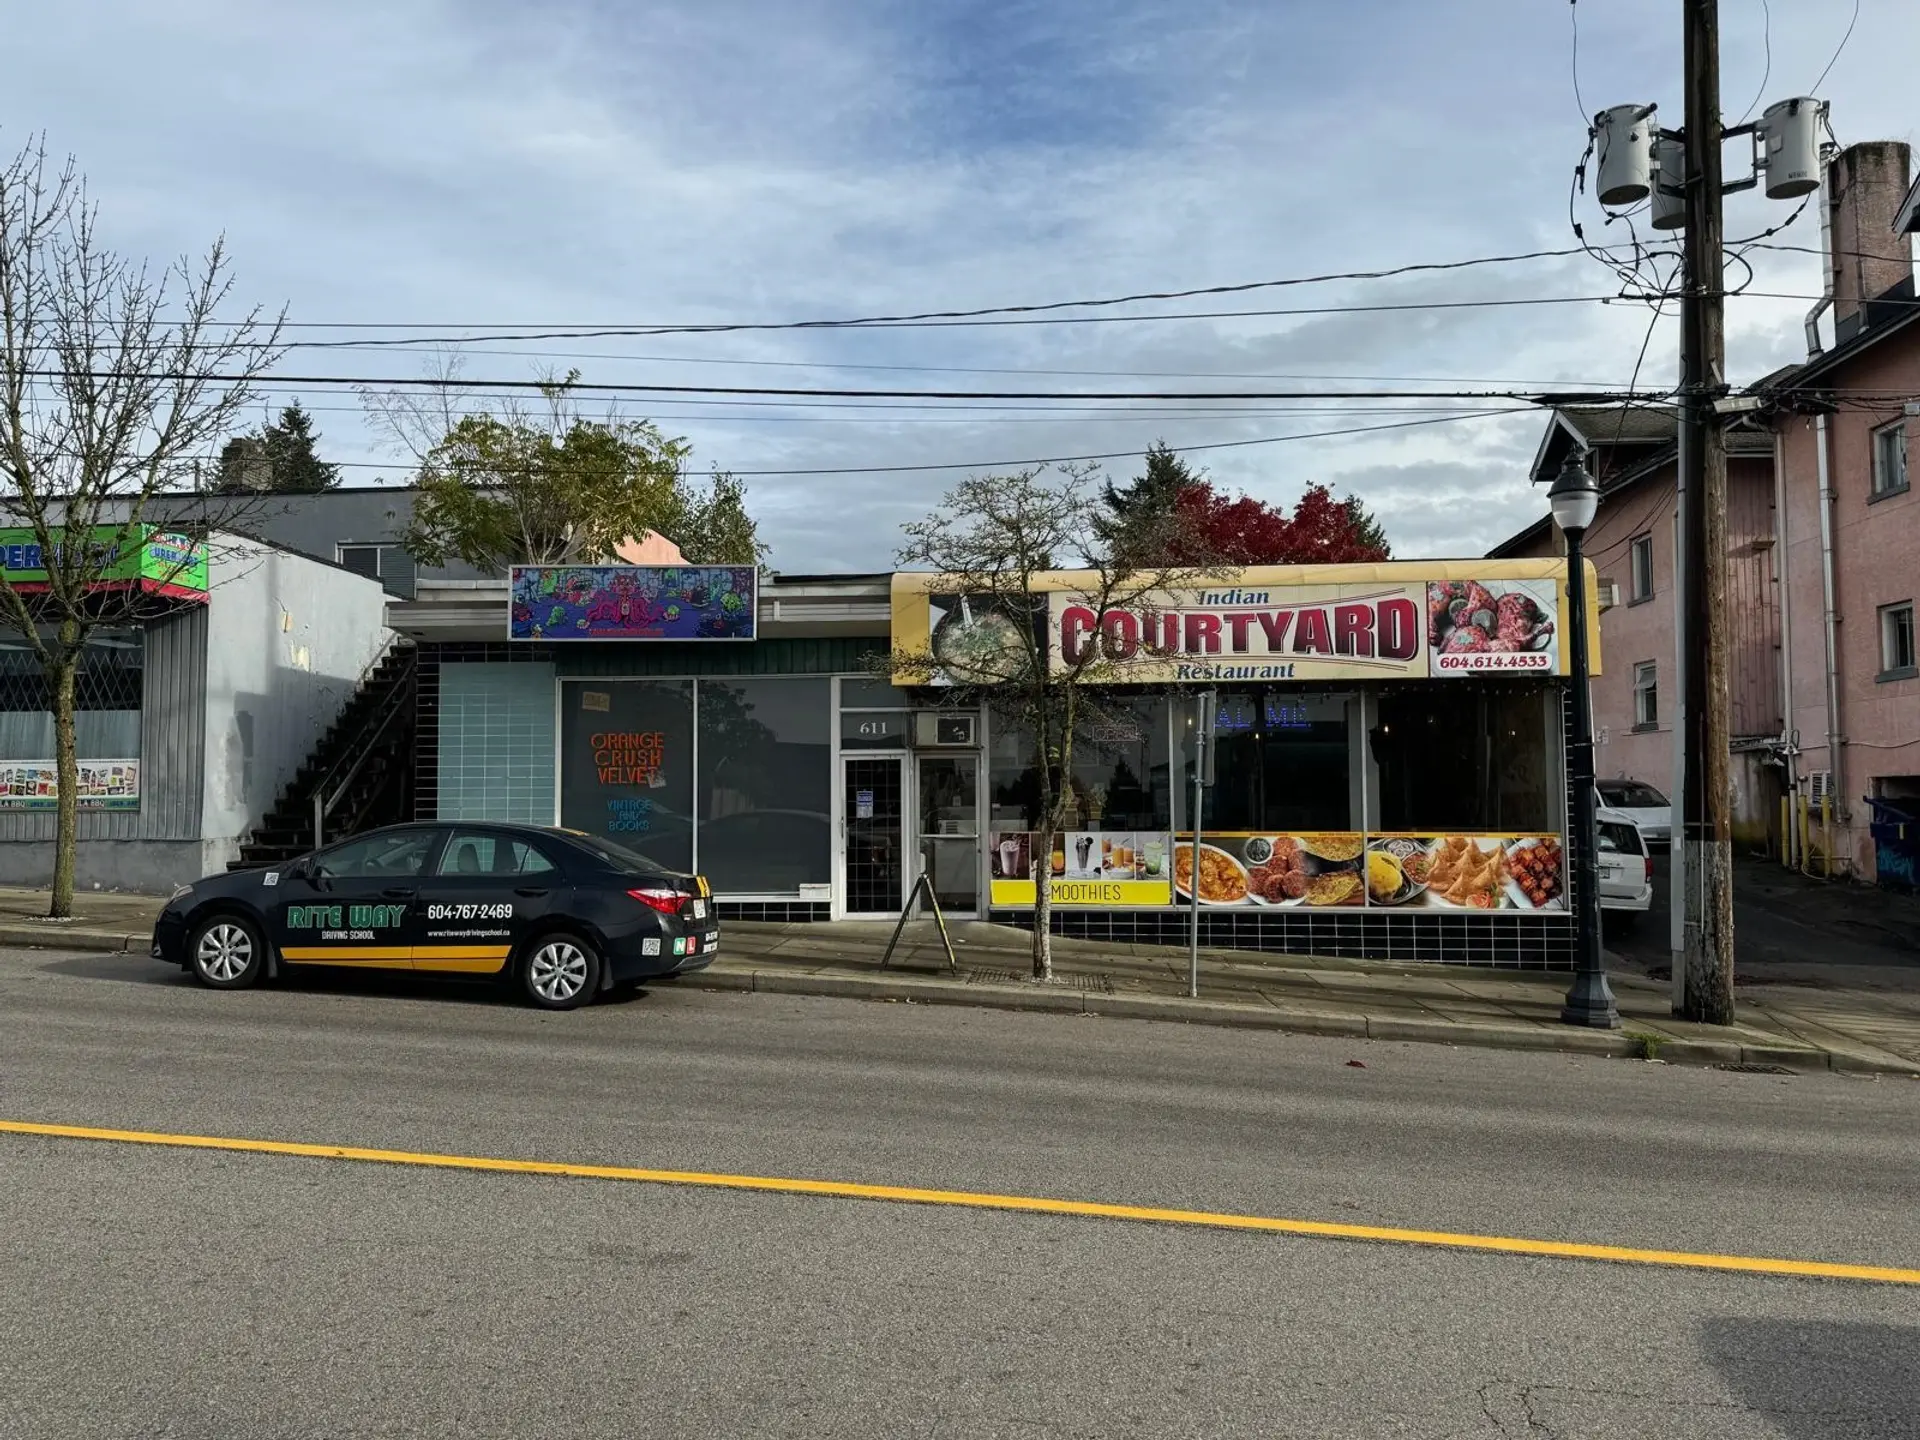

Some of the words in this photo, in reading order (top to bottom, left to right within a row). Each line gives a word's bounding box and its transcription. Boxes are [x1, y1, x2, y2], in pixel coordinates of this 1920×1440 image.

[1200, 589, 1269, 606] Indian
[1061, 597, 1419, 667] COURTYARD
[1440, 655, 1547, 669] 604.614.4533
[1177, 662, 1295, 681] Restaurant
[860, 721, 887, 734] 611
[590, 732, 665, 750] ORANGE
[594, 749, 662, 766] CRUSH
[597, 766, 658, 784] VELVET
[608, 820, 650, 832] BOOKS
[1050, 884, 1121, 900] MOOTHIES
[287, 905, 342, 928] RITE
[349, 904, 406, 928] WAY
[428, 904, 513, 919] 604-767-2469
[321, 930, 348, 940] DRIVING
[349, 930, 376, 940] SCHOOL
